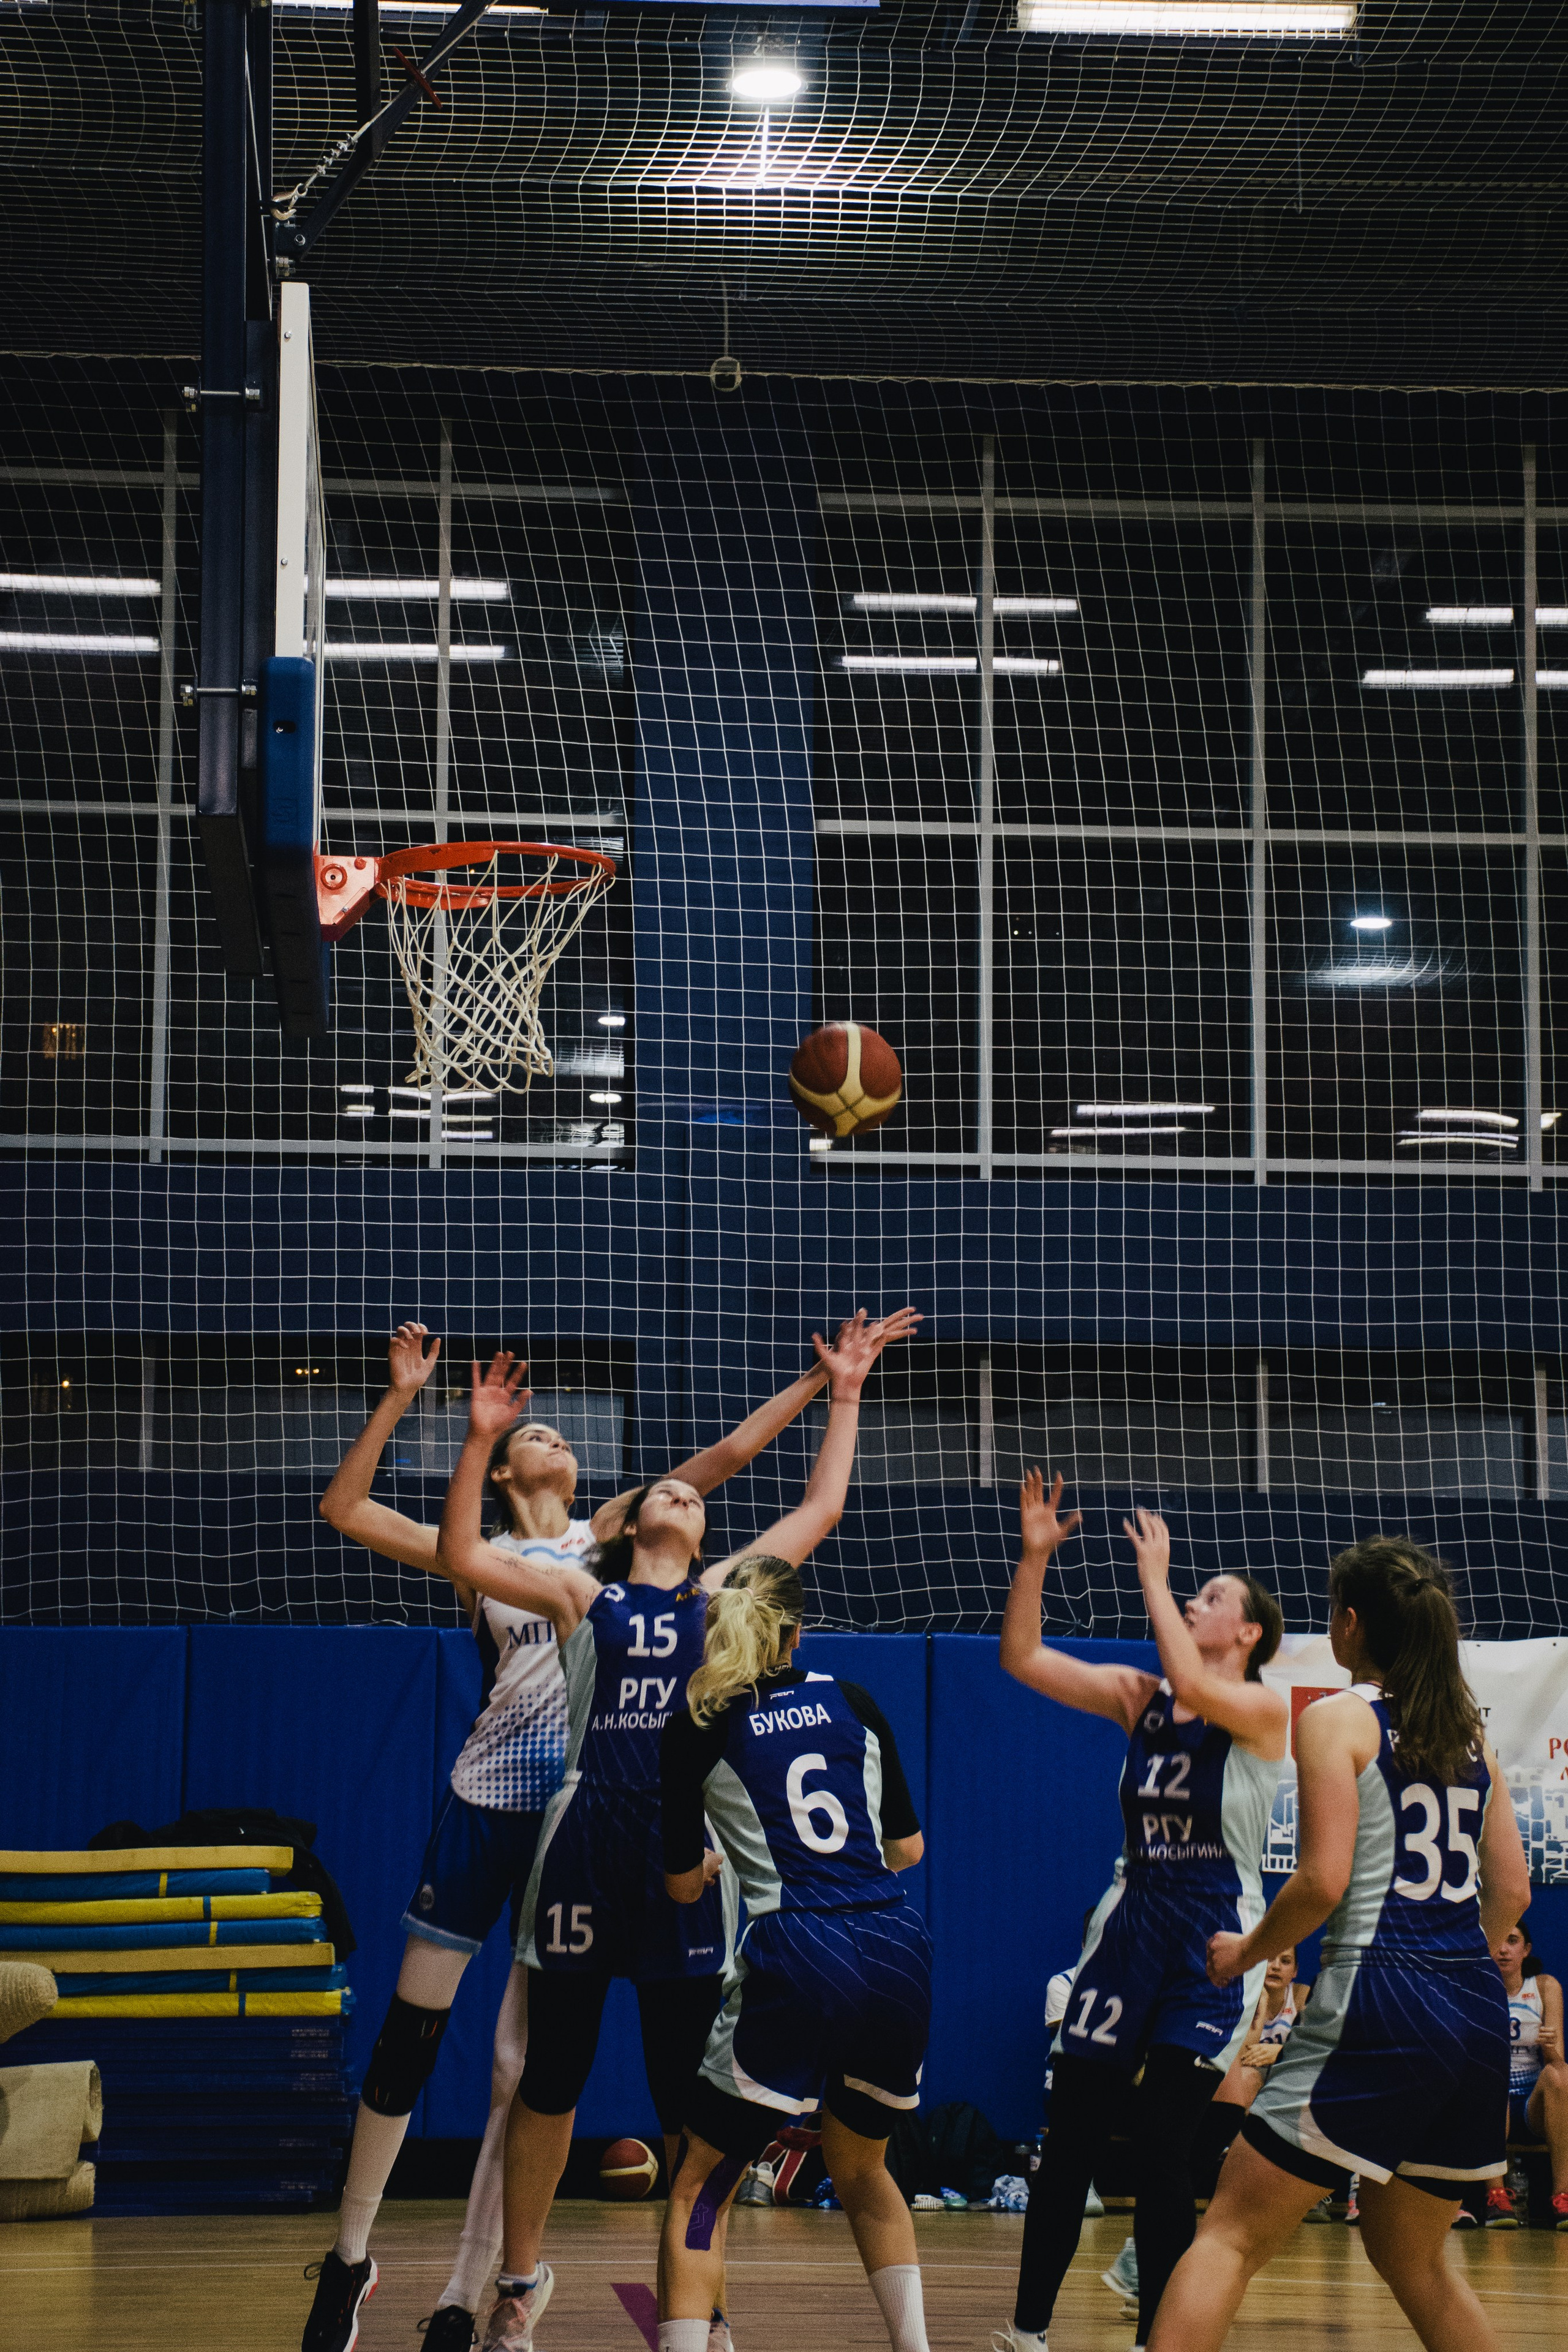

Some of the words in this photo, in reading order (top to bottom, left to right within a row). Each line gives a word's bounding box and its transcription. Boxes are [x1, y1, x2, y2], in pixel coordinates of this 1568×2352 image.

[627, 1612, 677, 1658] 15
[619, 1676, 677, 1709] РГУ
[592, 1711, 673, 1732] А.Н.КОСЫГ
[748, 1703, 832, 1736] БУКОВА
[1137, 1751, 1191, 1801] 12
[786, 1753, 849, 1853] 6
[1142, 1813, 1193, 1845] РГУ
[1393, 1782, 1479, 1904] 35
[546, 1902, 594, 1954] 15
[1068, 1988, 1123, 2047] 12
